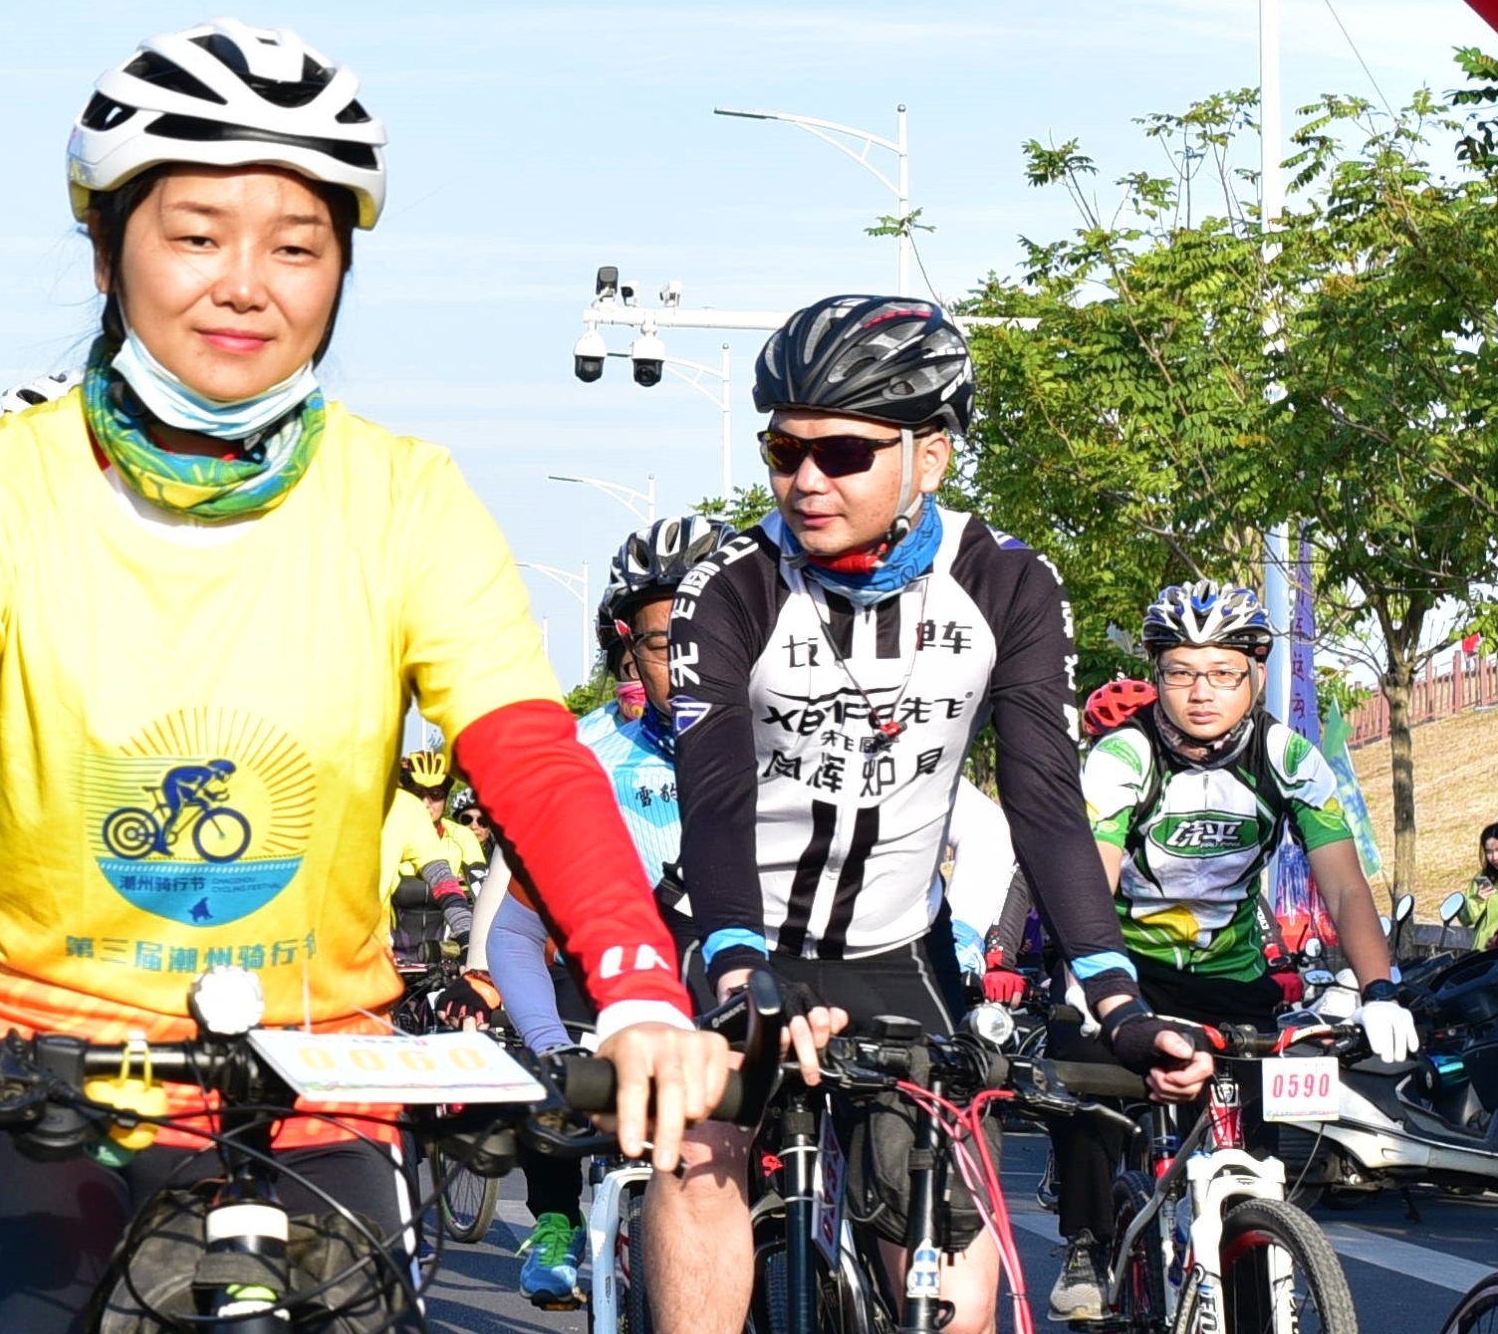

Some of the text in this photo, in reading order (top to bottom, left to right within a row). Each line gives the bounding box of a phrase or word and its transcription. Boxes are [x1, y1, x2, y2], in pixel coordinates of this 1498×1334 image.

[119, 874, 206, 893] 潮州骑行节
[297, 1047, 488, 1072] 0060
[1271, 1073, 1331, 1099] 0590
